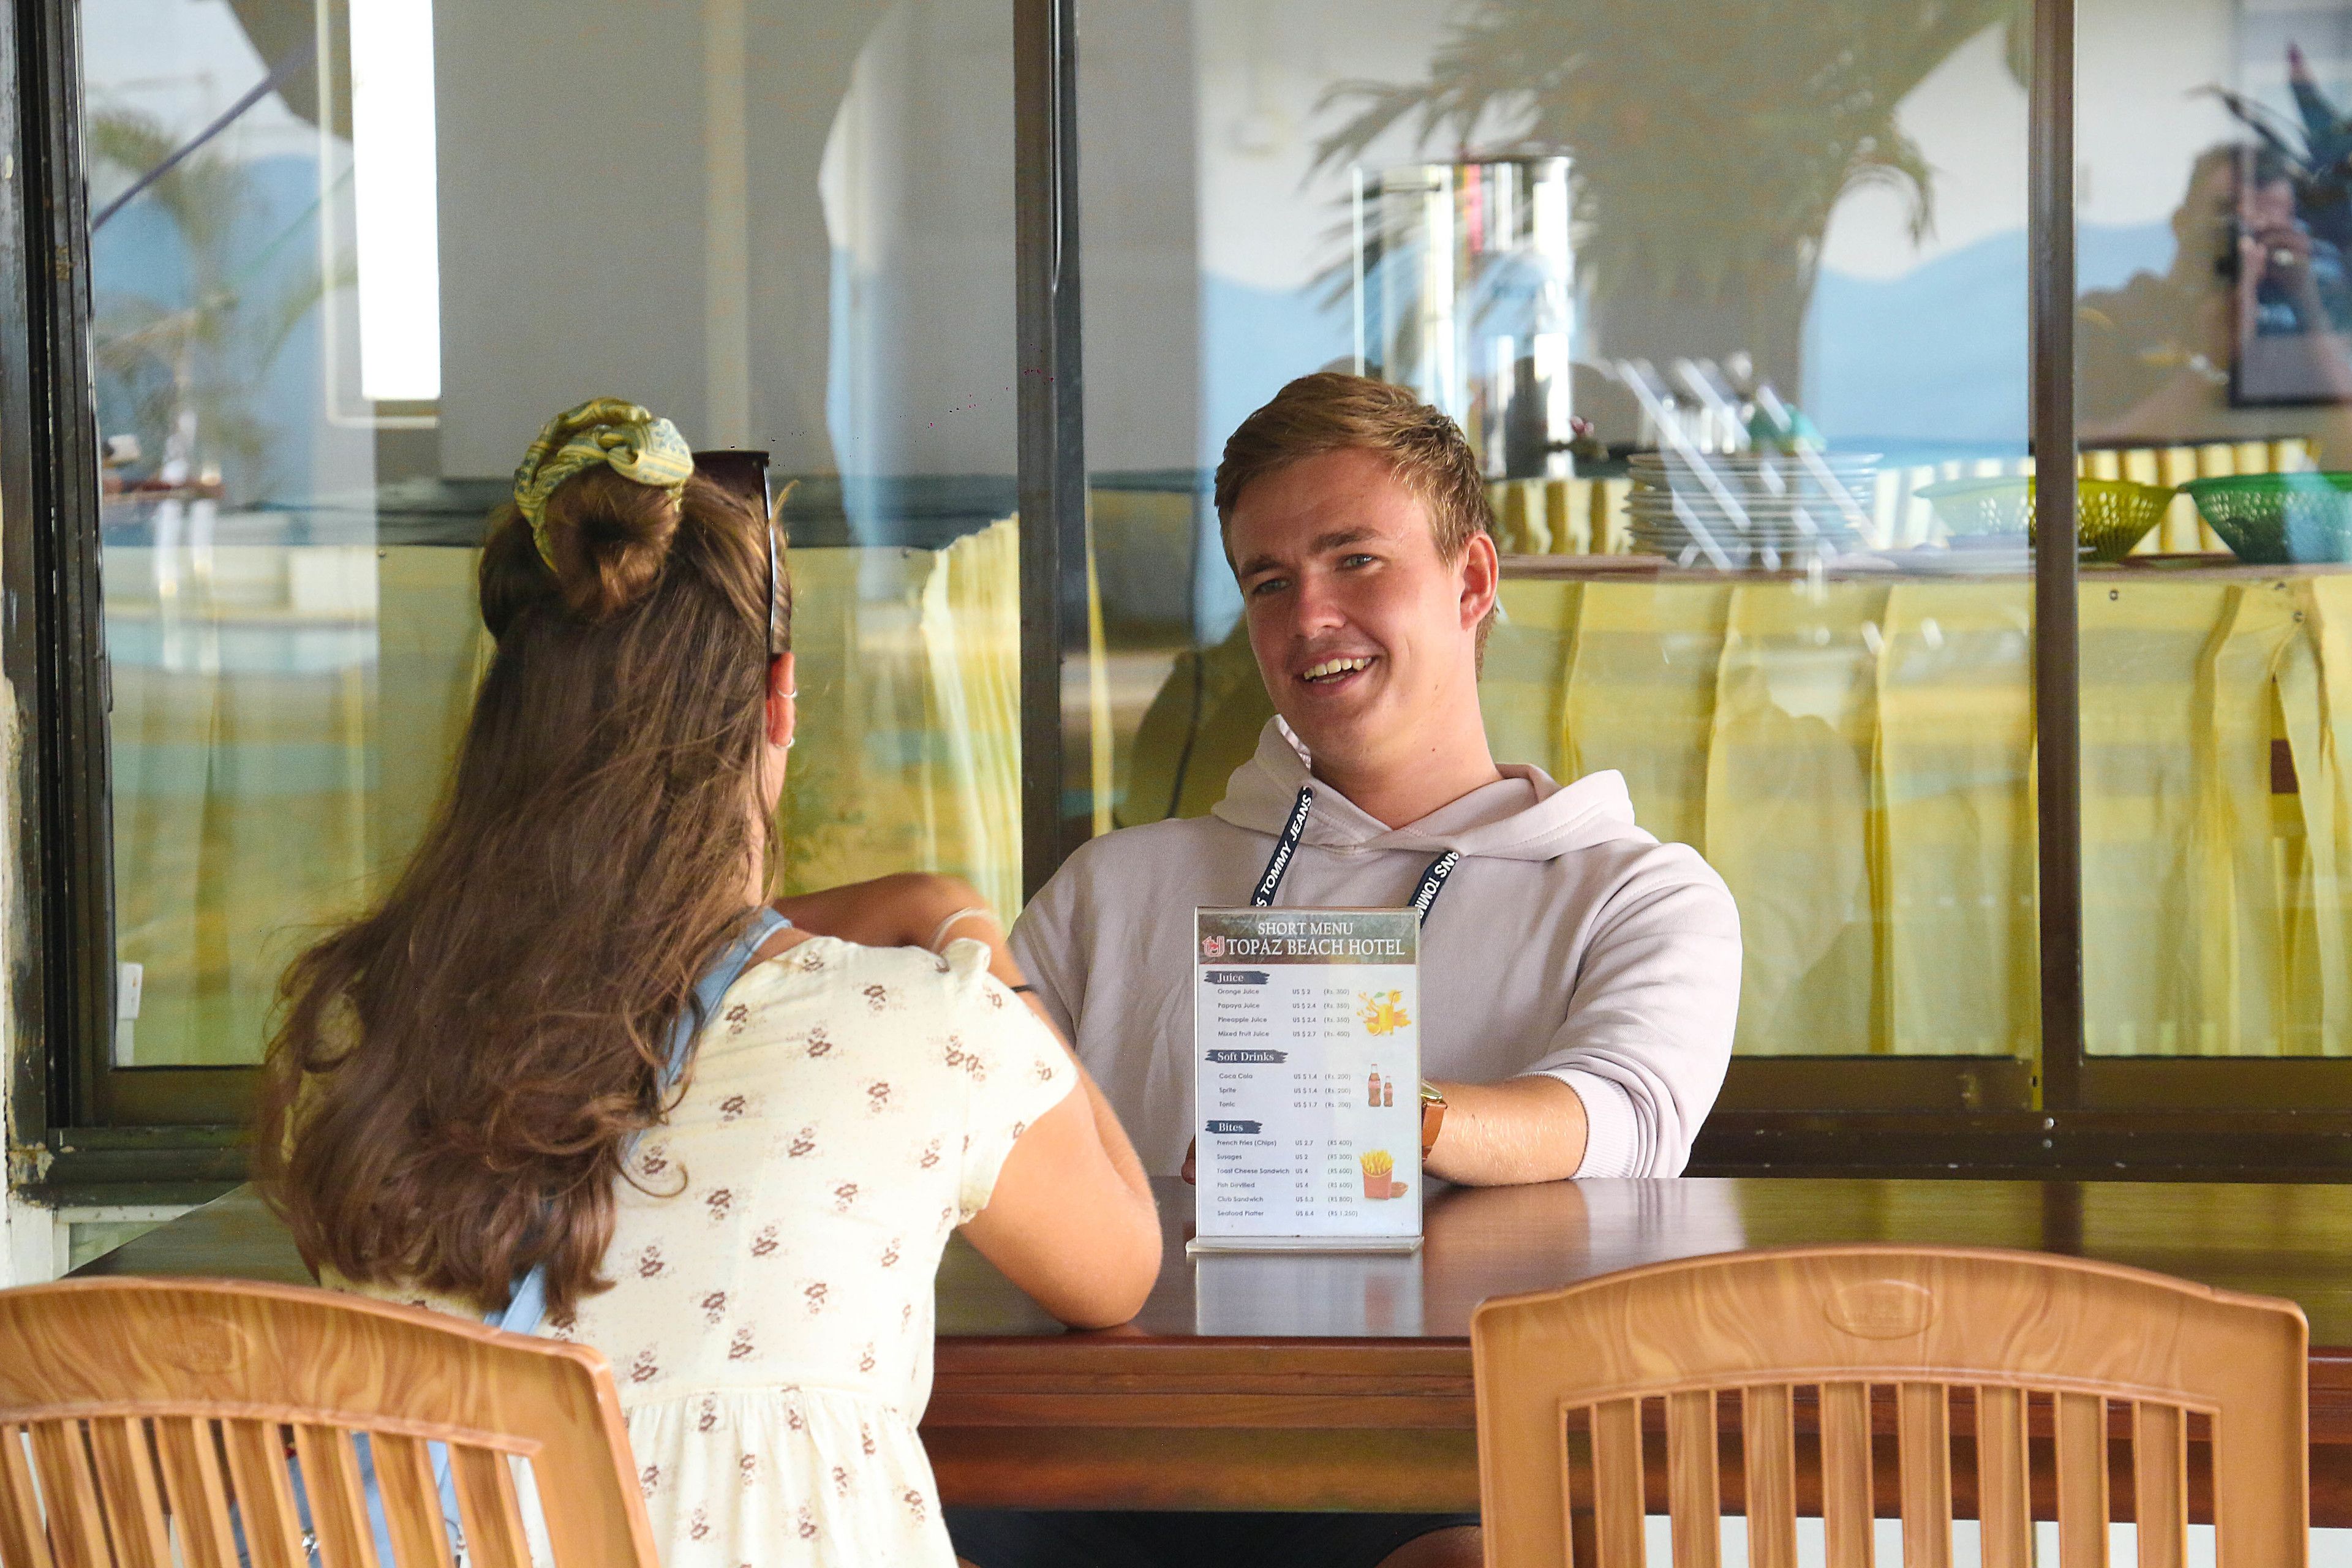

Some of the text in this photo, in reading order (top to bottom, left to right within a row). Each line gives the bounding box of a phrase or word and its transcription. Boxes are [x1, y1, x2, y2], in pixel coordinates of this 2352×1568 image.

[1261, 840, 1291, 895] TOMMY
[1290, 794, 1311, 842] JEANS
[1258, 922, 1354, 935] SHORT MENU
[1226, 938, 1405, 956] TOPAZ BEACH HOTEL
[1218, 973, 1243, 982] Juice
[1218, 1052, 1273, 1061] Soft Drinks
[1219, 1123, 1243, 1131] Bites
